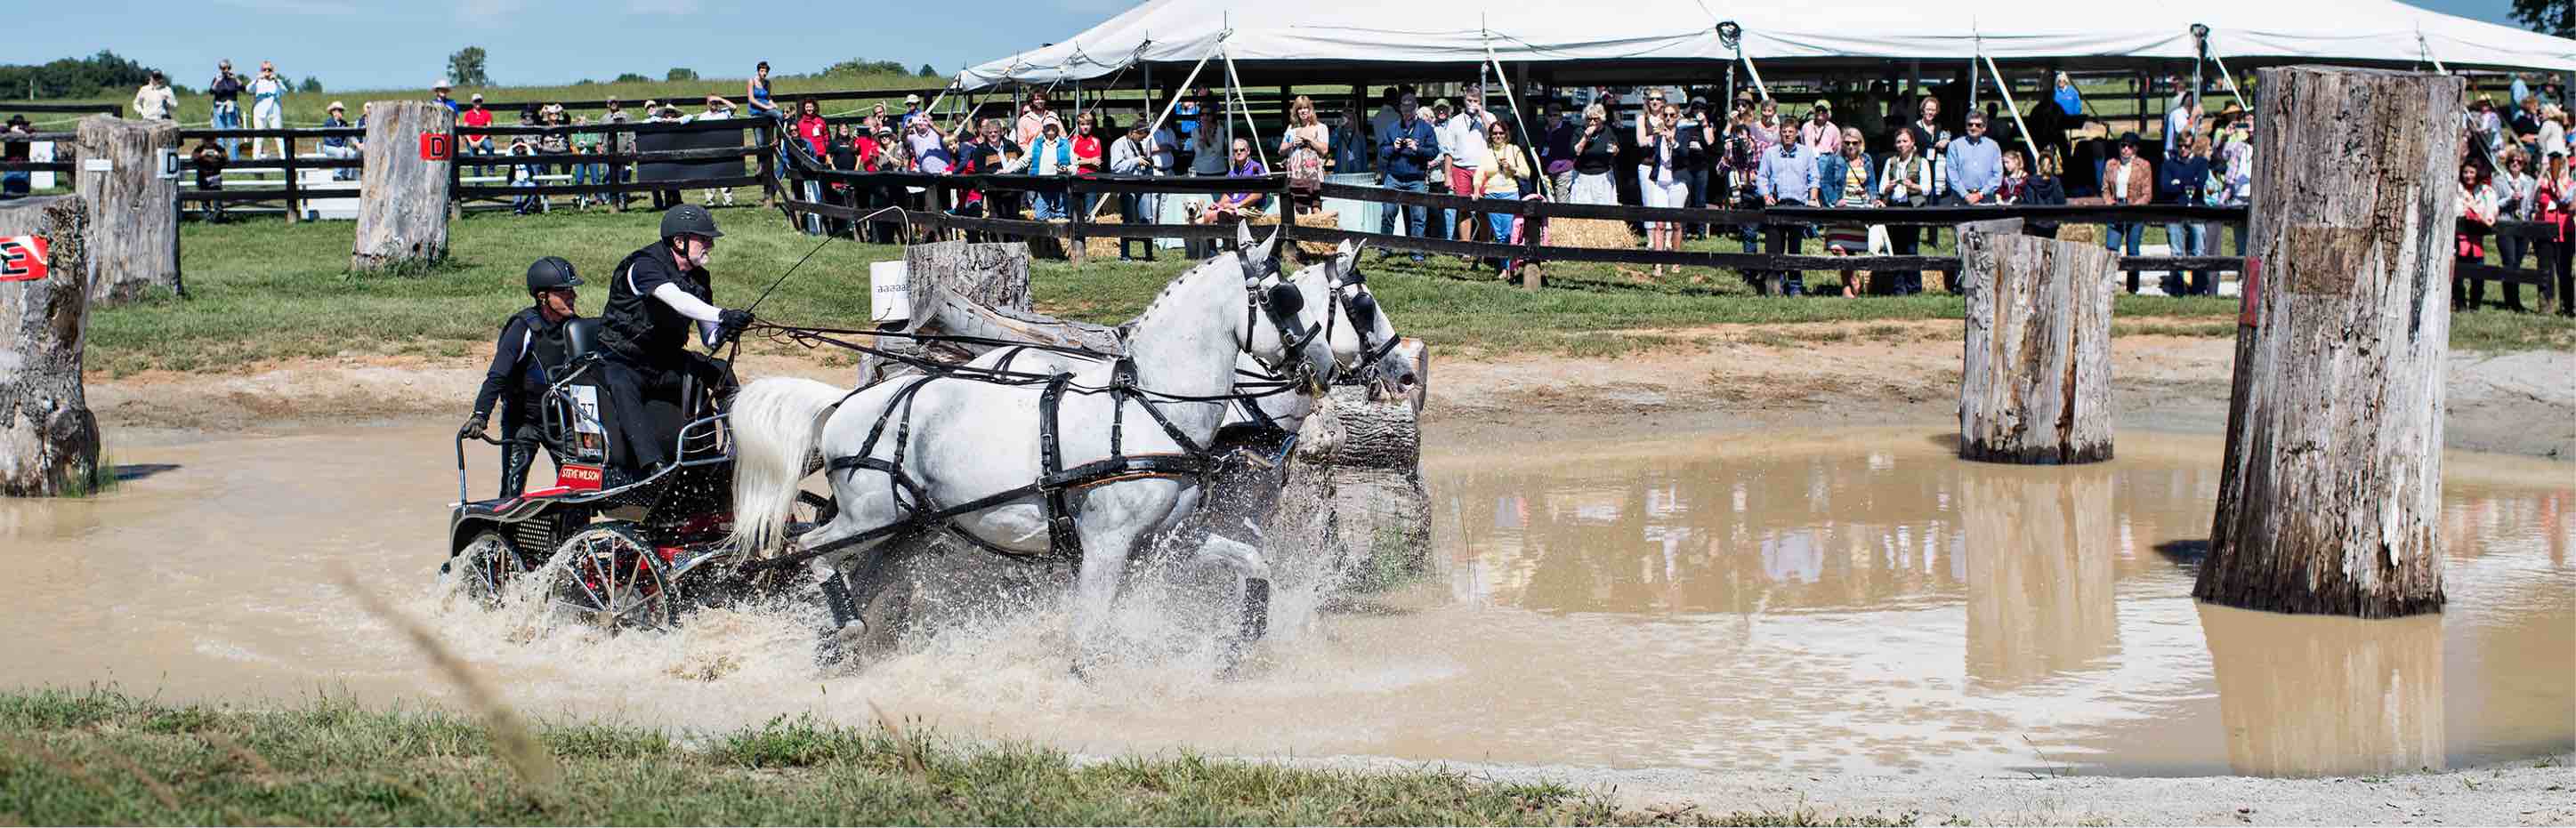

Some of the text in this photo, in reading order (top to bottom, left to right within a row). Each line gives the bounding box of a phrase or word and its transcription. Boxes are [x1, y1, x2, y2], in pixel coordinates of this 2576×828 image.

[431, 137, 445, 157] D
[167, 152, 178, 174] D
[0, 242, 28, 276] E
[561, 469, 599, 481] STEVE WILSON
